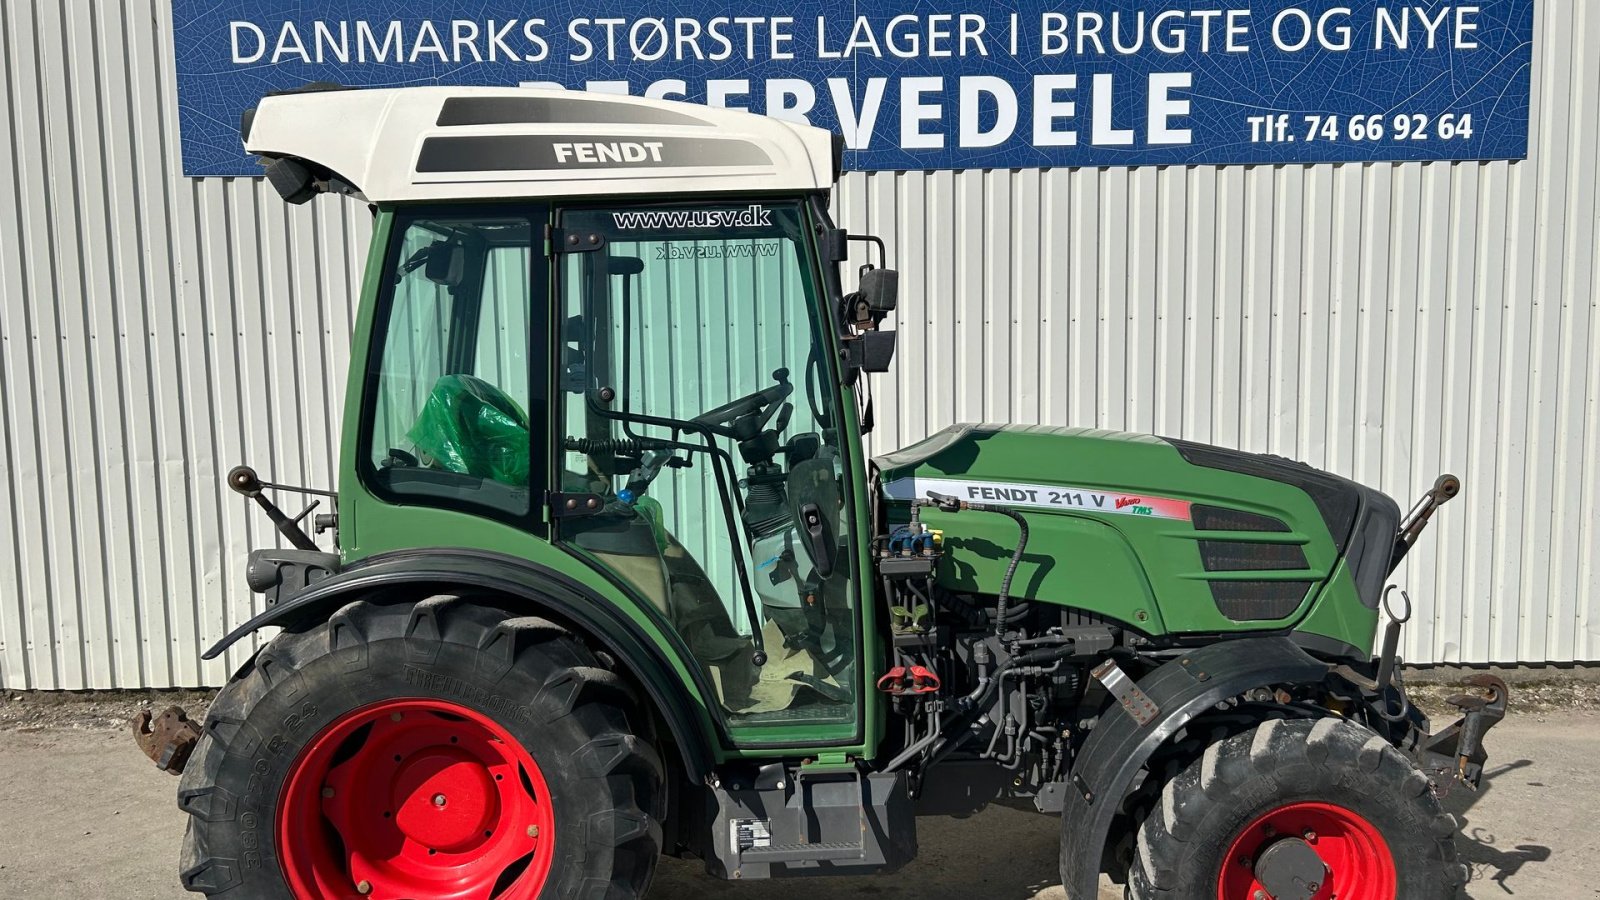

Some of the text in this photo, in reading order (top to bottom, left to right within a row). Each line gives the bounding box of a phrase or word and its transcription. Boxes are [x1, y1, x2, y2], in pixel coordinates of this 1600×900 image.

[229, 6, 1479, 64] DANMARKS STØRSTE LAGER I BRUGTE OG NYE
[519, 72, 1192, 150] RVEDELE
[1247, 113, 1473, 143] Tlf. 74 66 92 64
[552, 141, 664, 163] FENDT
[612, 204, 772, 229] www.usv.dk
[967, 486, 1105, 508] FENDT 211 V
[1132, 505, 1153, 516] TMS
